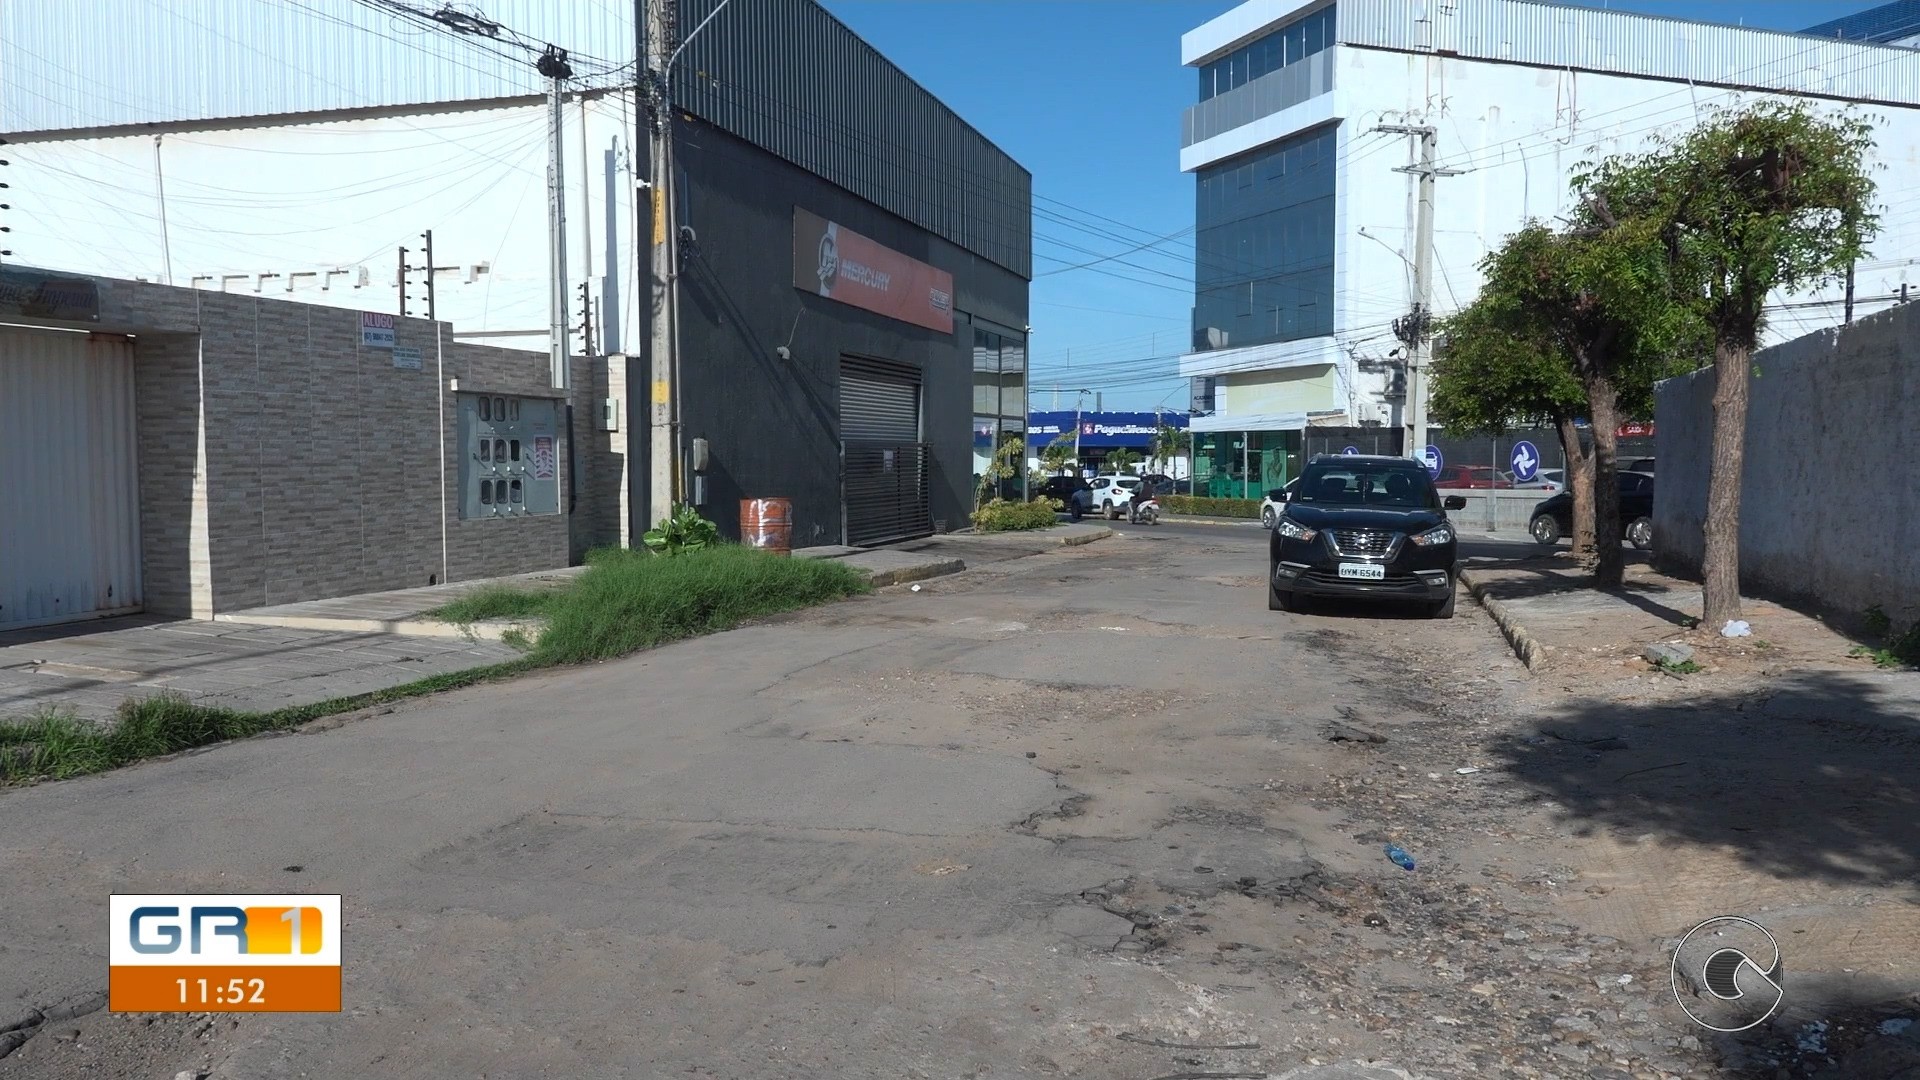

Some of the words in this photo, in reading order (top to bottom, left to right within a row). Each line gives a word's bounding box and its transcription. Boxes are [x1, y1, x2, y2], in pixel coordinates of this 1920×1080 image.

[840, 258, 891, 291] MERCURY
[364, 313, 393, 328] ALUGO
[1360, 569, 1381, 577] 6544
